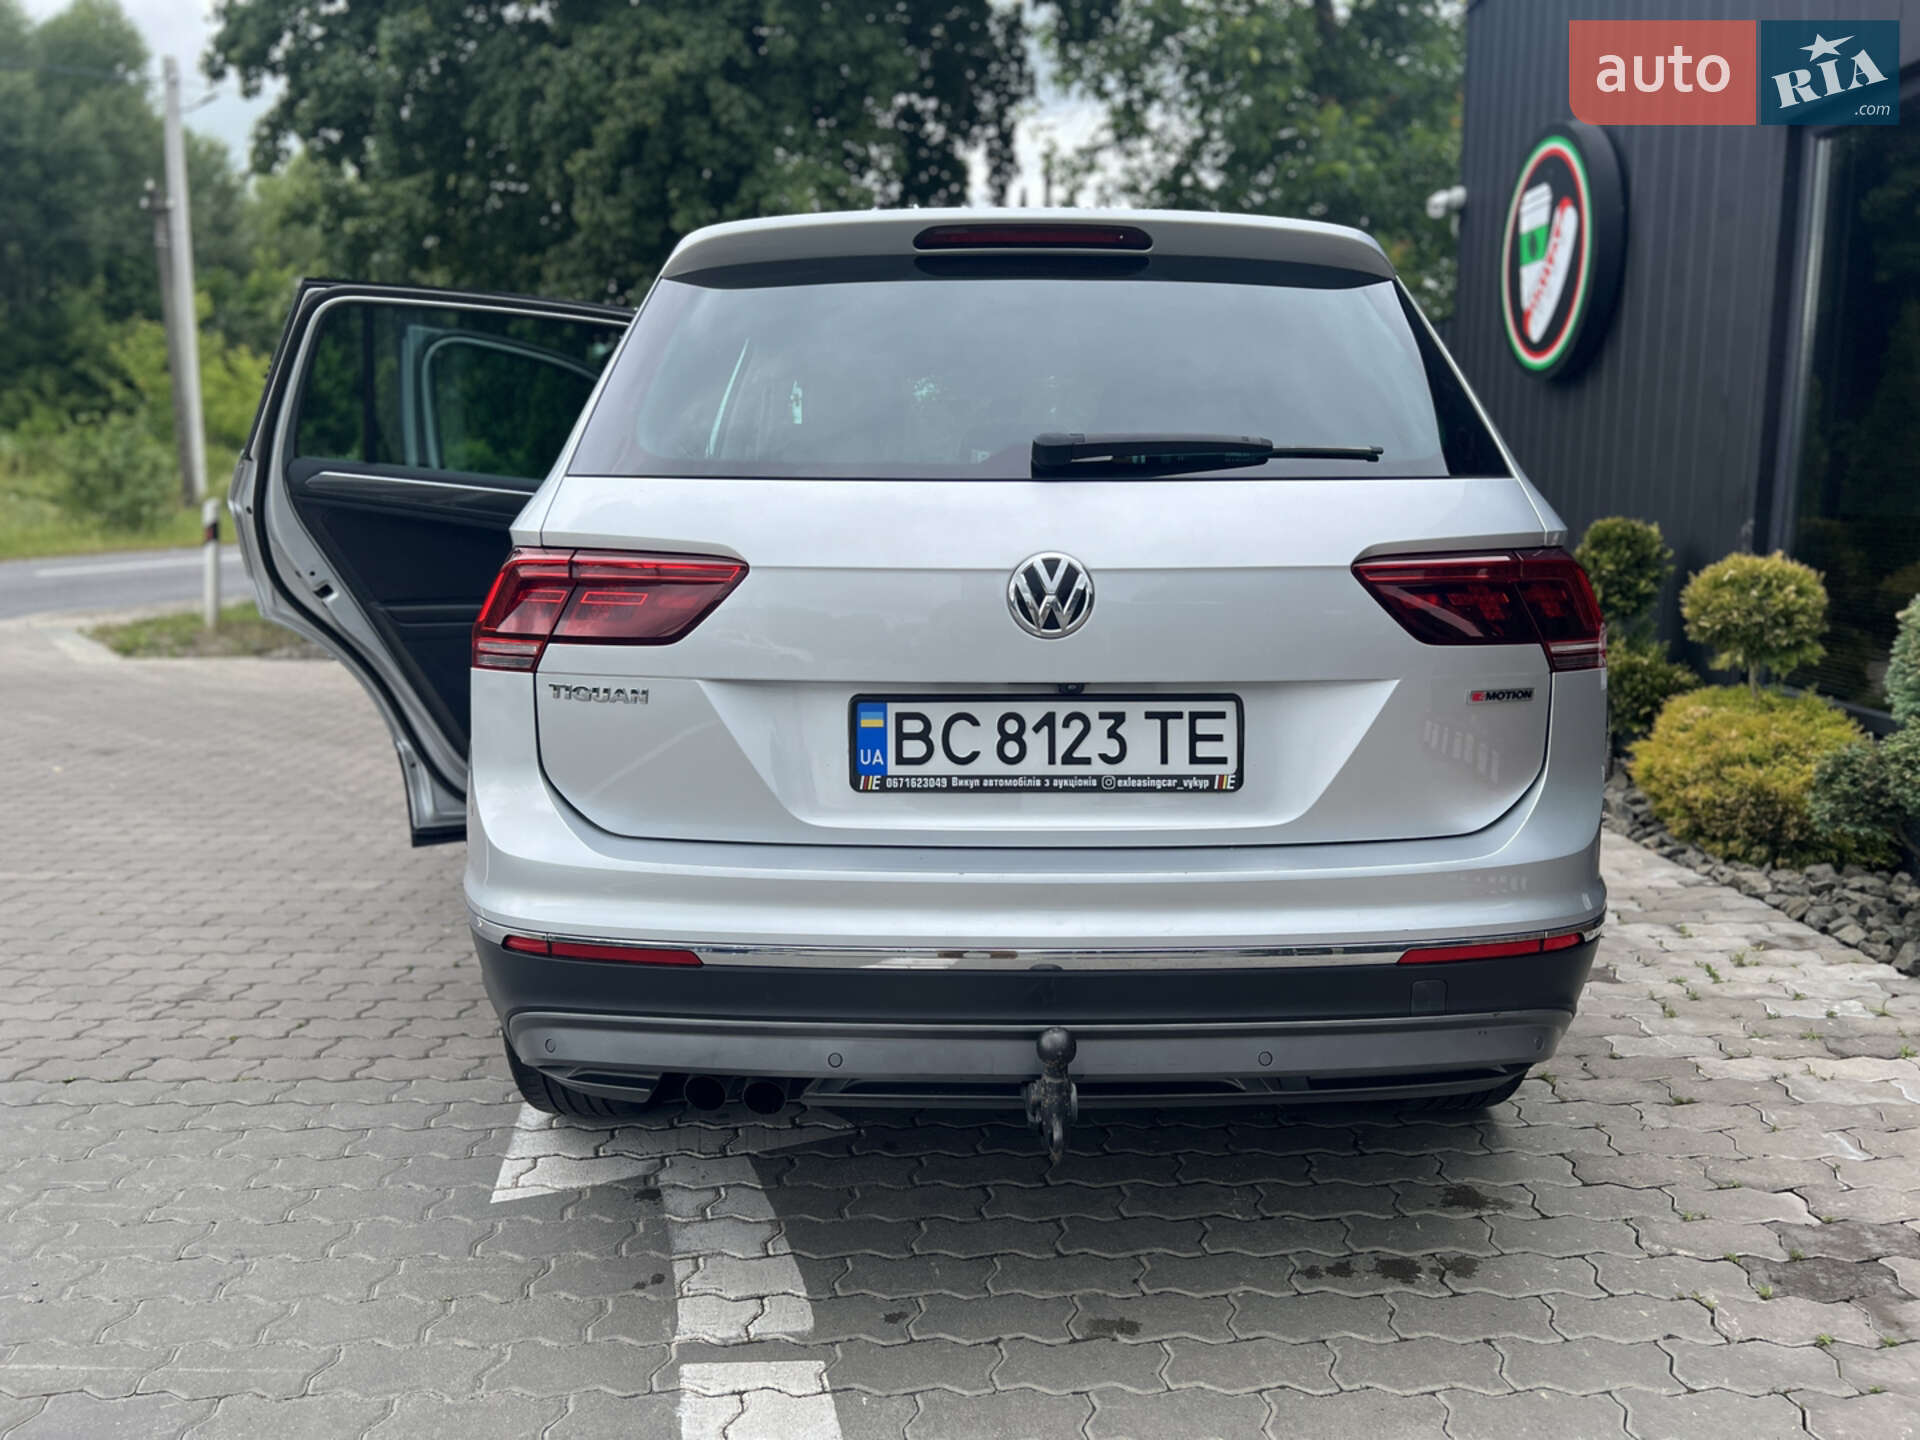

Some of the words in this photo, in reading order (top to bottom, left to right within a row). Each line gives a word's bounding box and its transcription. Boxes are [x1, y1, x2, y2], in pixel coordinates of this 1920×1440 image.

[548, 683, 650, 705] TIGUAN
[894, 711, 982, 766] BC
[996, 711, 1128, 766] 8123
[1144, 711, 1229, 765] TE
[860, 749, 884, 766] UA
[951, 776, 980, 789] Викуп
